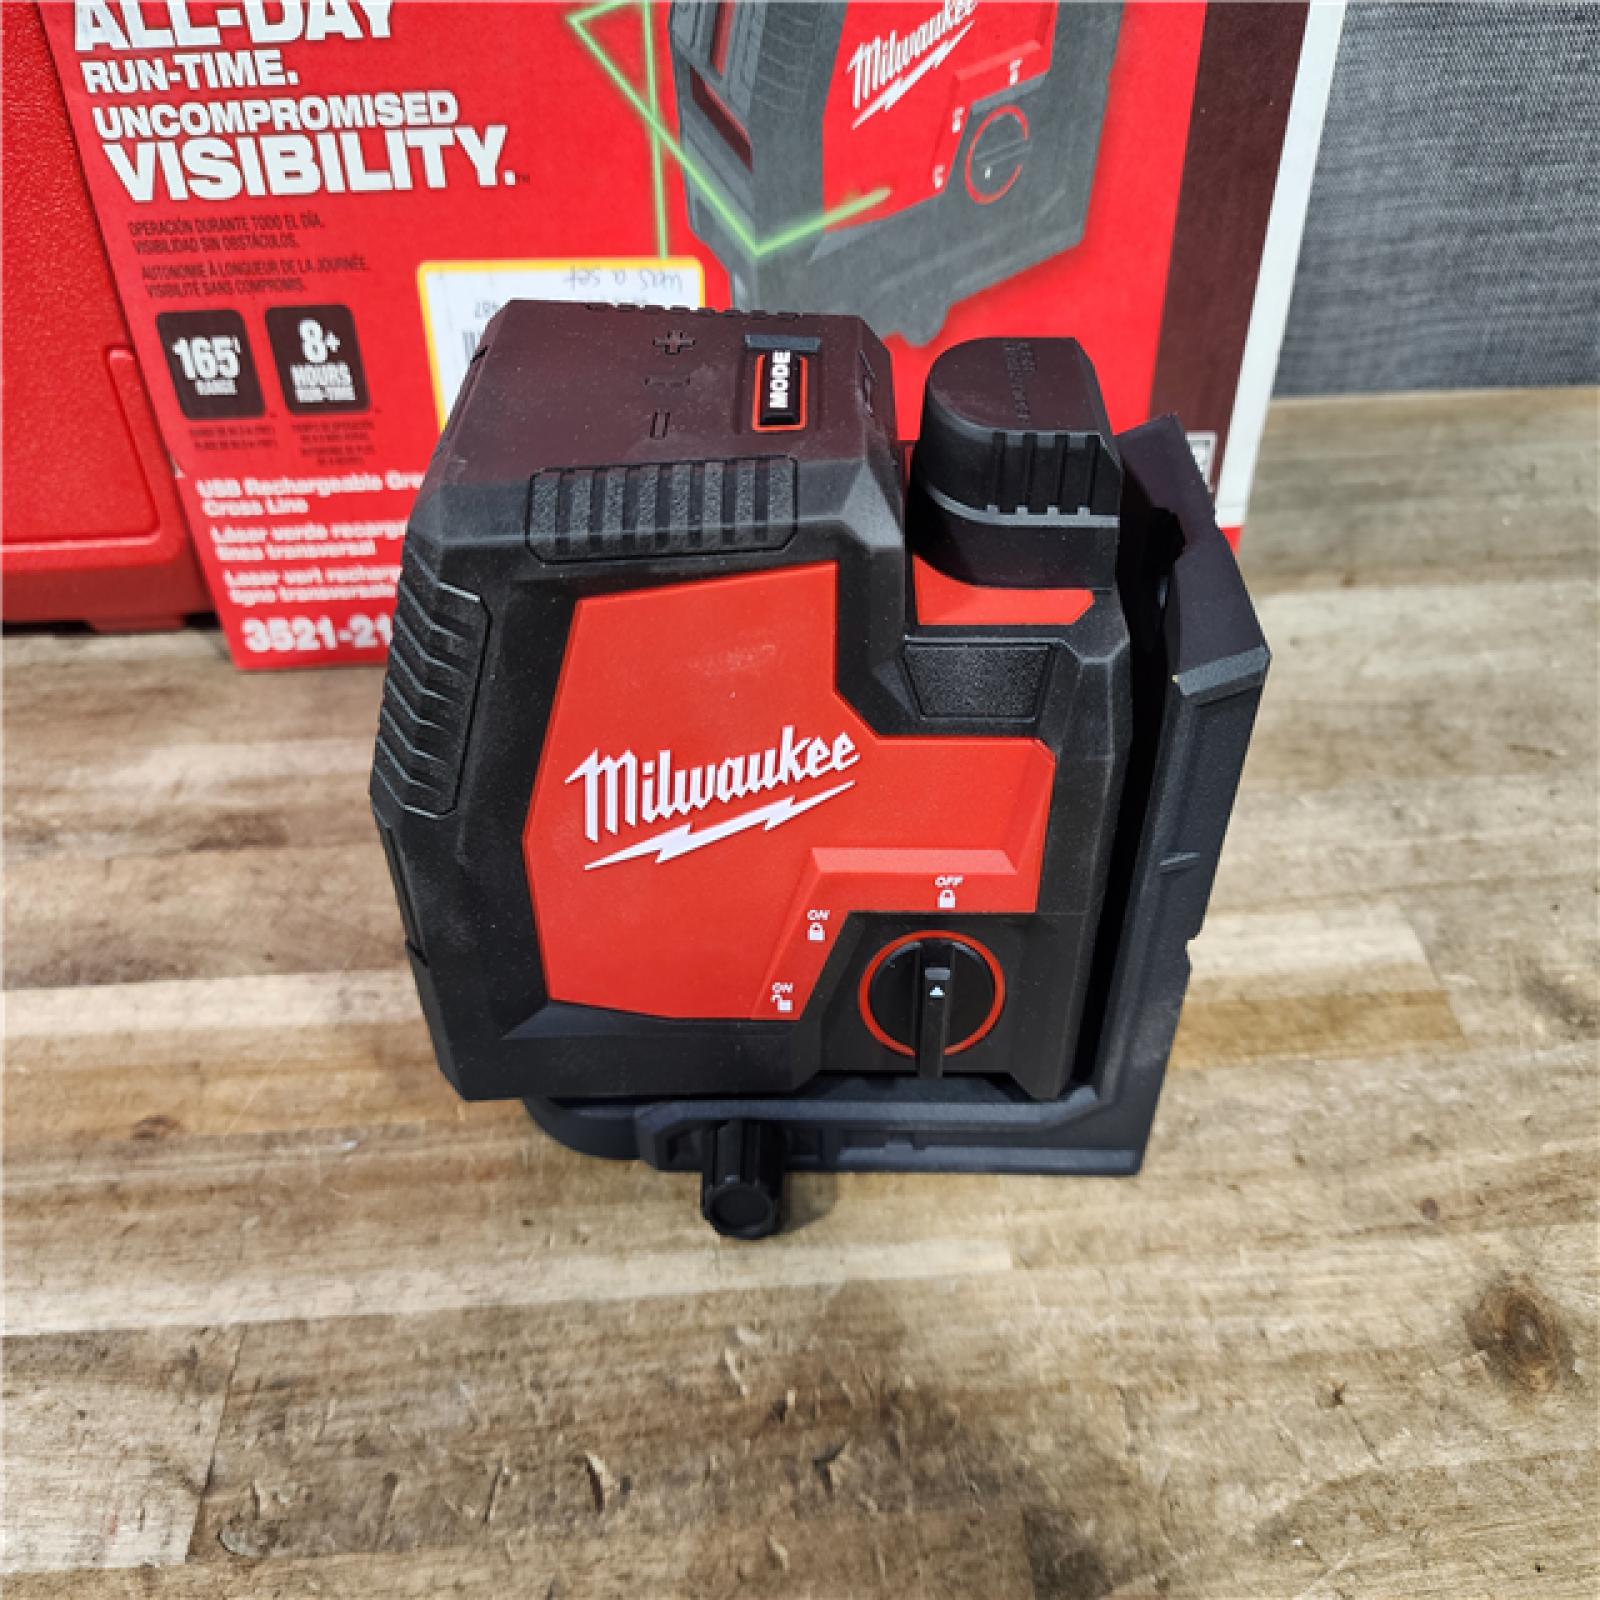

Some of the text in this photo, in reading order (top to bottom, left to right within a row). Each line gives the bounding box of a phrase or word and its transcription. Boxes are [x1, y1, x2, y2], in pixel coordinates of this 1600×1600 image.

[74, 0, 393, 51] ALL-DAY
[80, 49, 299, 93] RUN-TIME.
[92, 90, 459, 139] UNCOMPROMISED
[298, 317, 342, 363] 8+
[769, 349, 791, 409] MODE
[564, 724, 861, 844] Milwaukee
[934, 875, 964, 888] OFF
[806, 909, 831, 920] ON
[772, 982, 794, 993] ON
